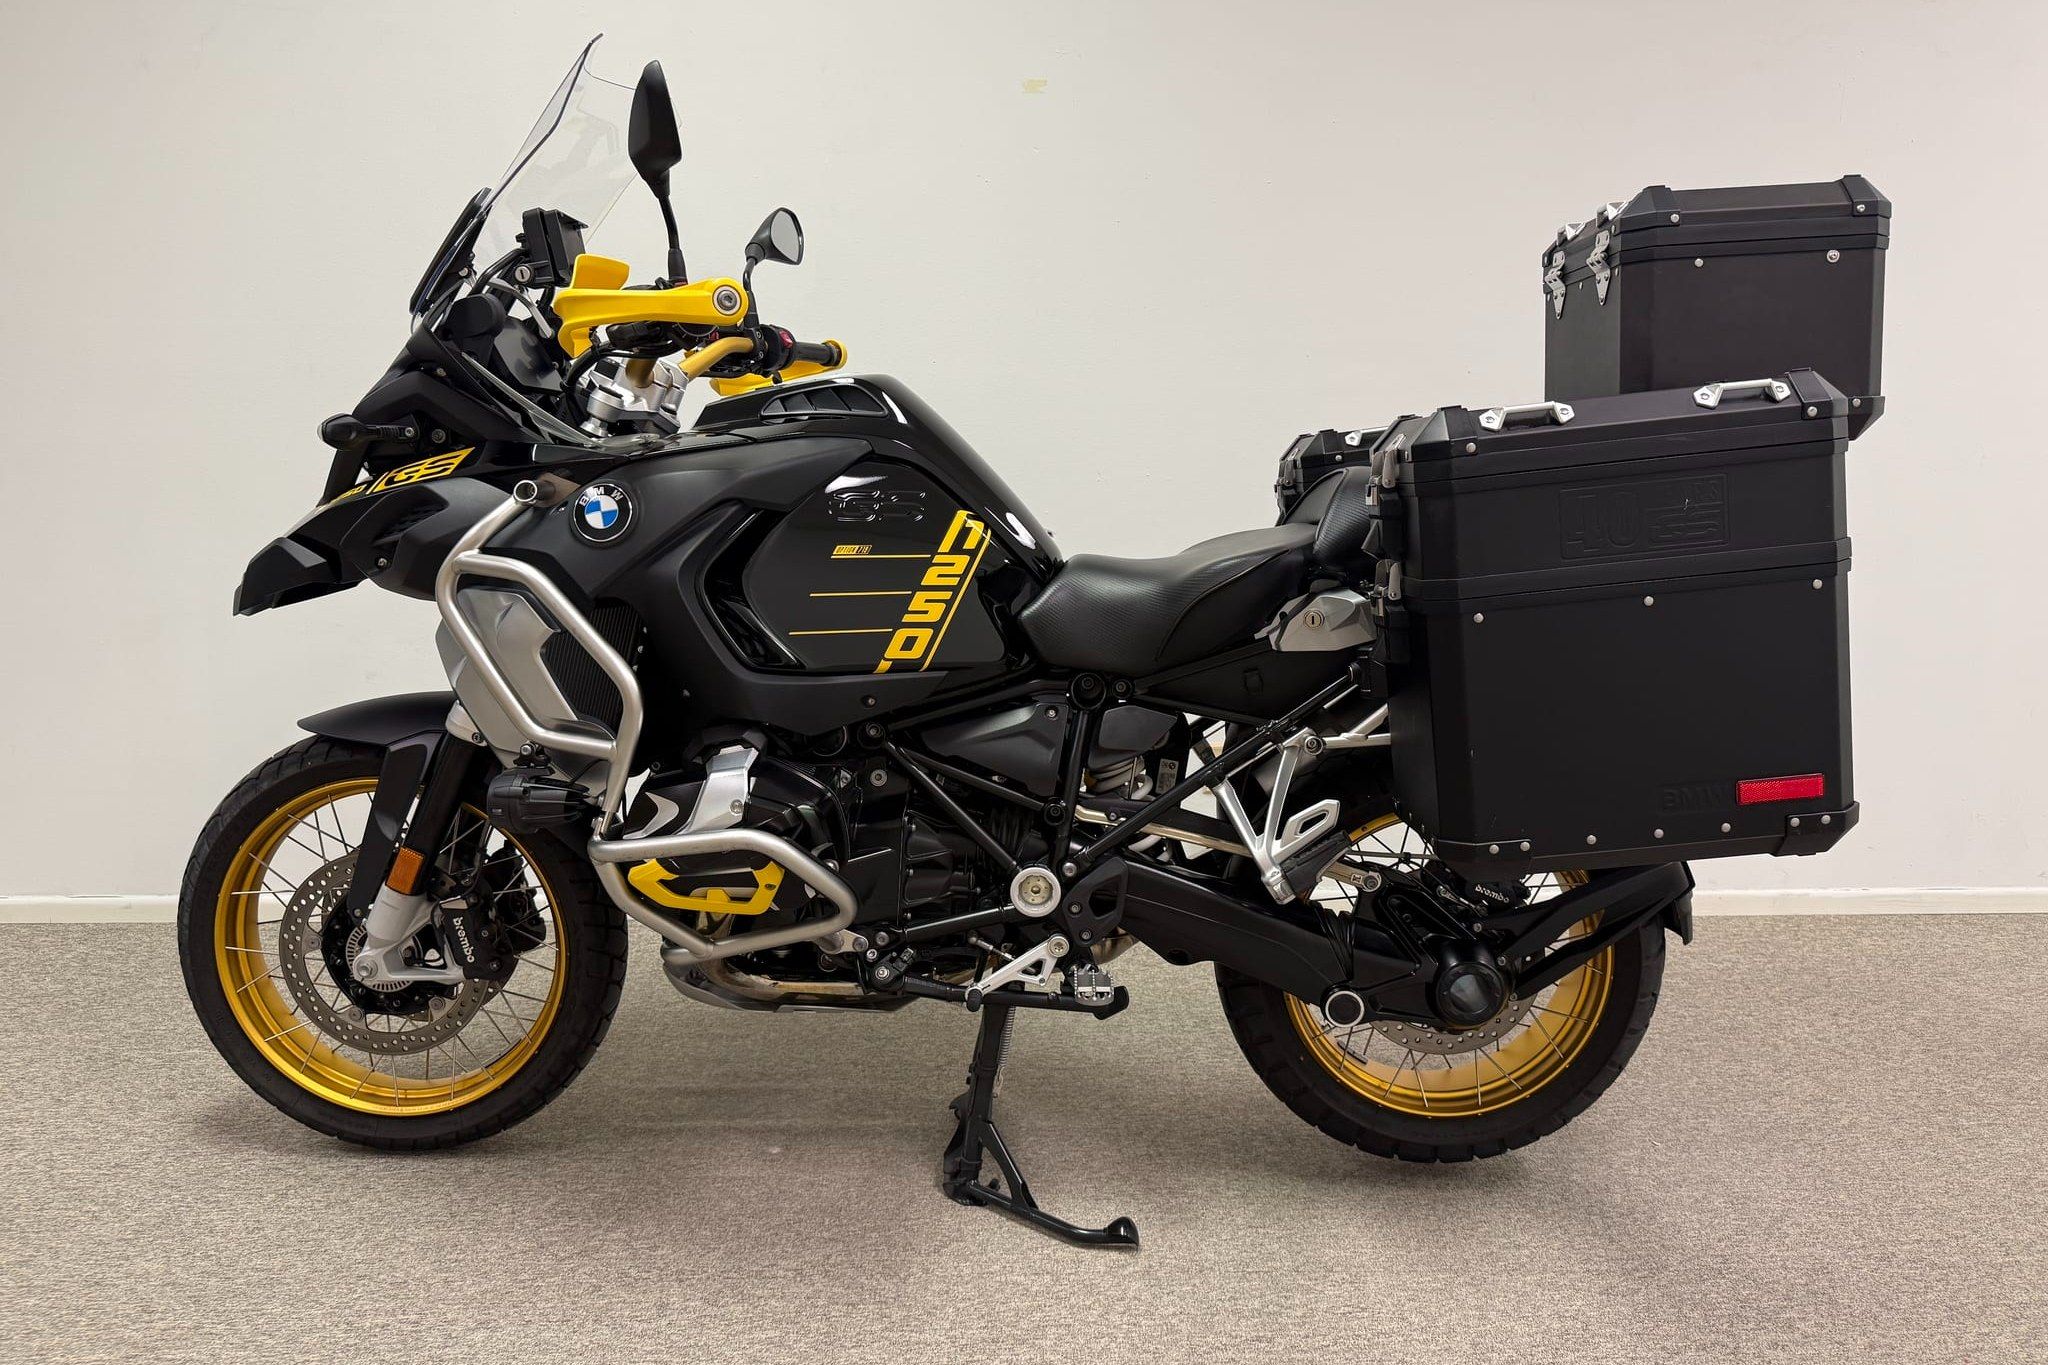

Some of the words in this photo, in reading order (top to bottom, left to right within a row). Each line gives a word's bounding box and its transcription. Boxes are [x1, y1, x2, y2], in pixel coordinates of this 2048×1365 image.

[579, 486, 624, 506] BMW
[1475, 883, 1510, 904] brembo
[453, 916, 475, 964] brembo
